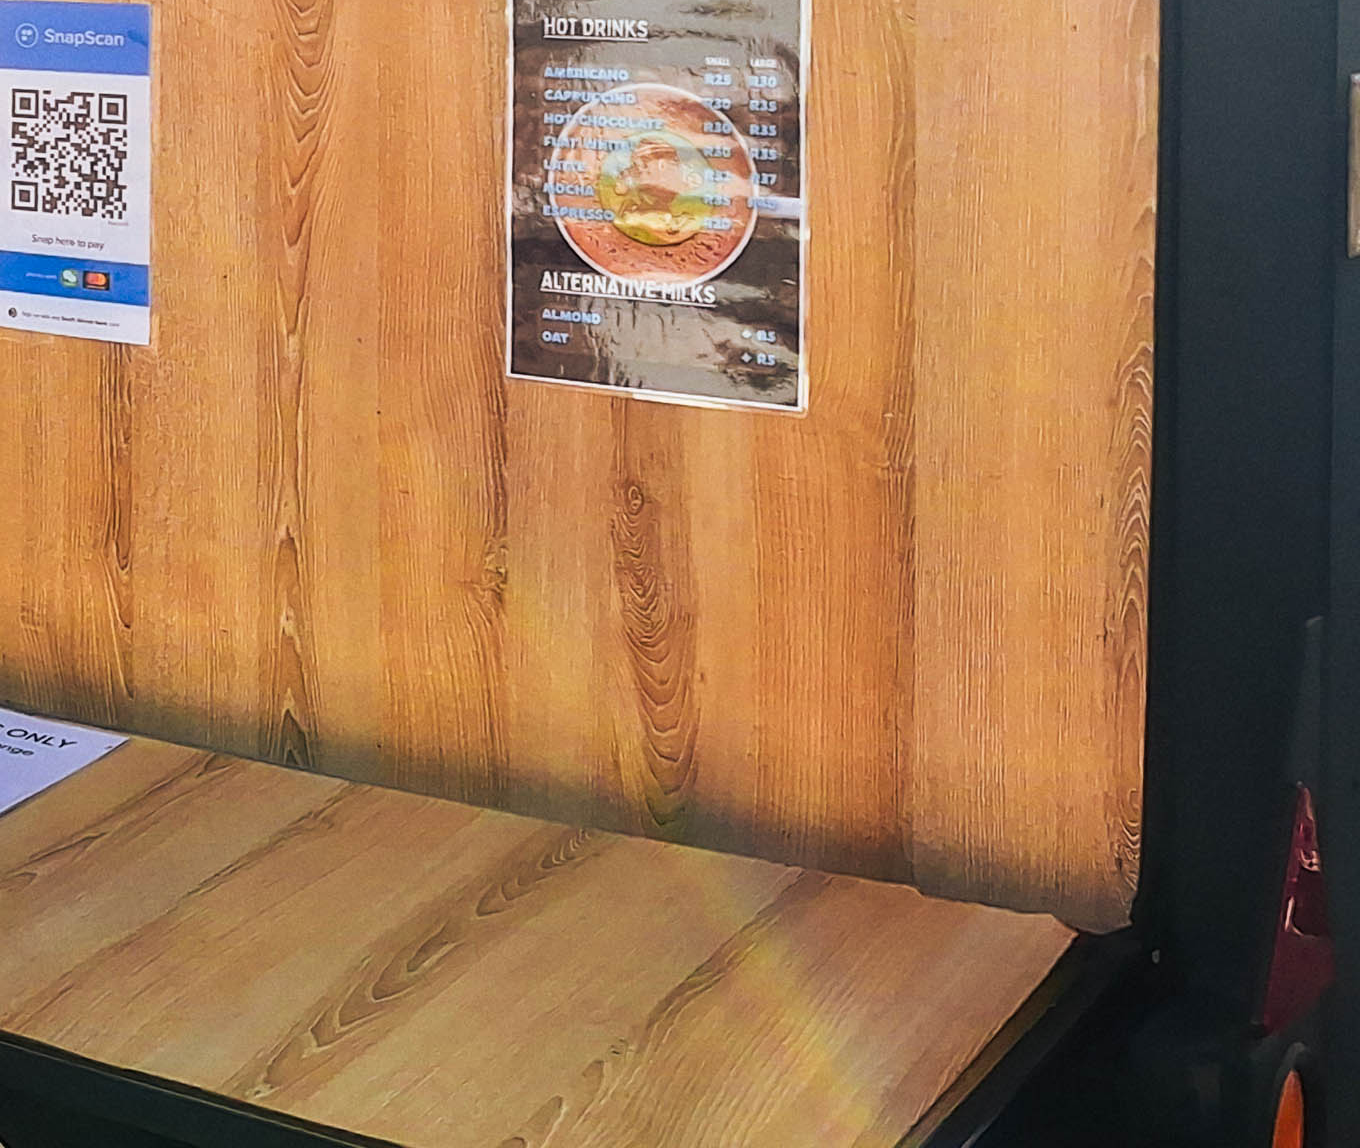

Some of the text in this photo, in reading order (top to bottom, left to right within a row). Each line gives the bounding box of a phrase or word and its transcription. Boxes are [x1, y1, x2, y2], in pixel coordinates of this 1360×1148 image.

[543, 17, 649, 38] HOT DRINKS
[43, 28, 125, 47] SnapScan
[544, 66, 629, 81] AMERICANO
[748, 75, 777, 88] R30
[544, 89, 777, 112] CAPPUCCINO R30 R35
[543, 112, 777, 137] HOT CHOCOLATE R30 R35
[543, 183, 595, 197] MOCHA
[542, 204, 616, 221] ESPRESSO
[32, 234, 105, 251] Snap here to pay
[540, 271, 717, 304] ALTERNATIVE MILKS
[542, 309, 602, 325] ALMOND
[542, 330, 570, 344] OAT
[756, 352, 776, 366] R5
[6, 728, 79, 750] ONLY
